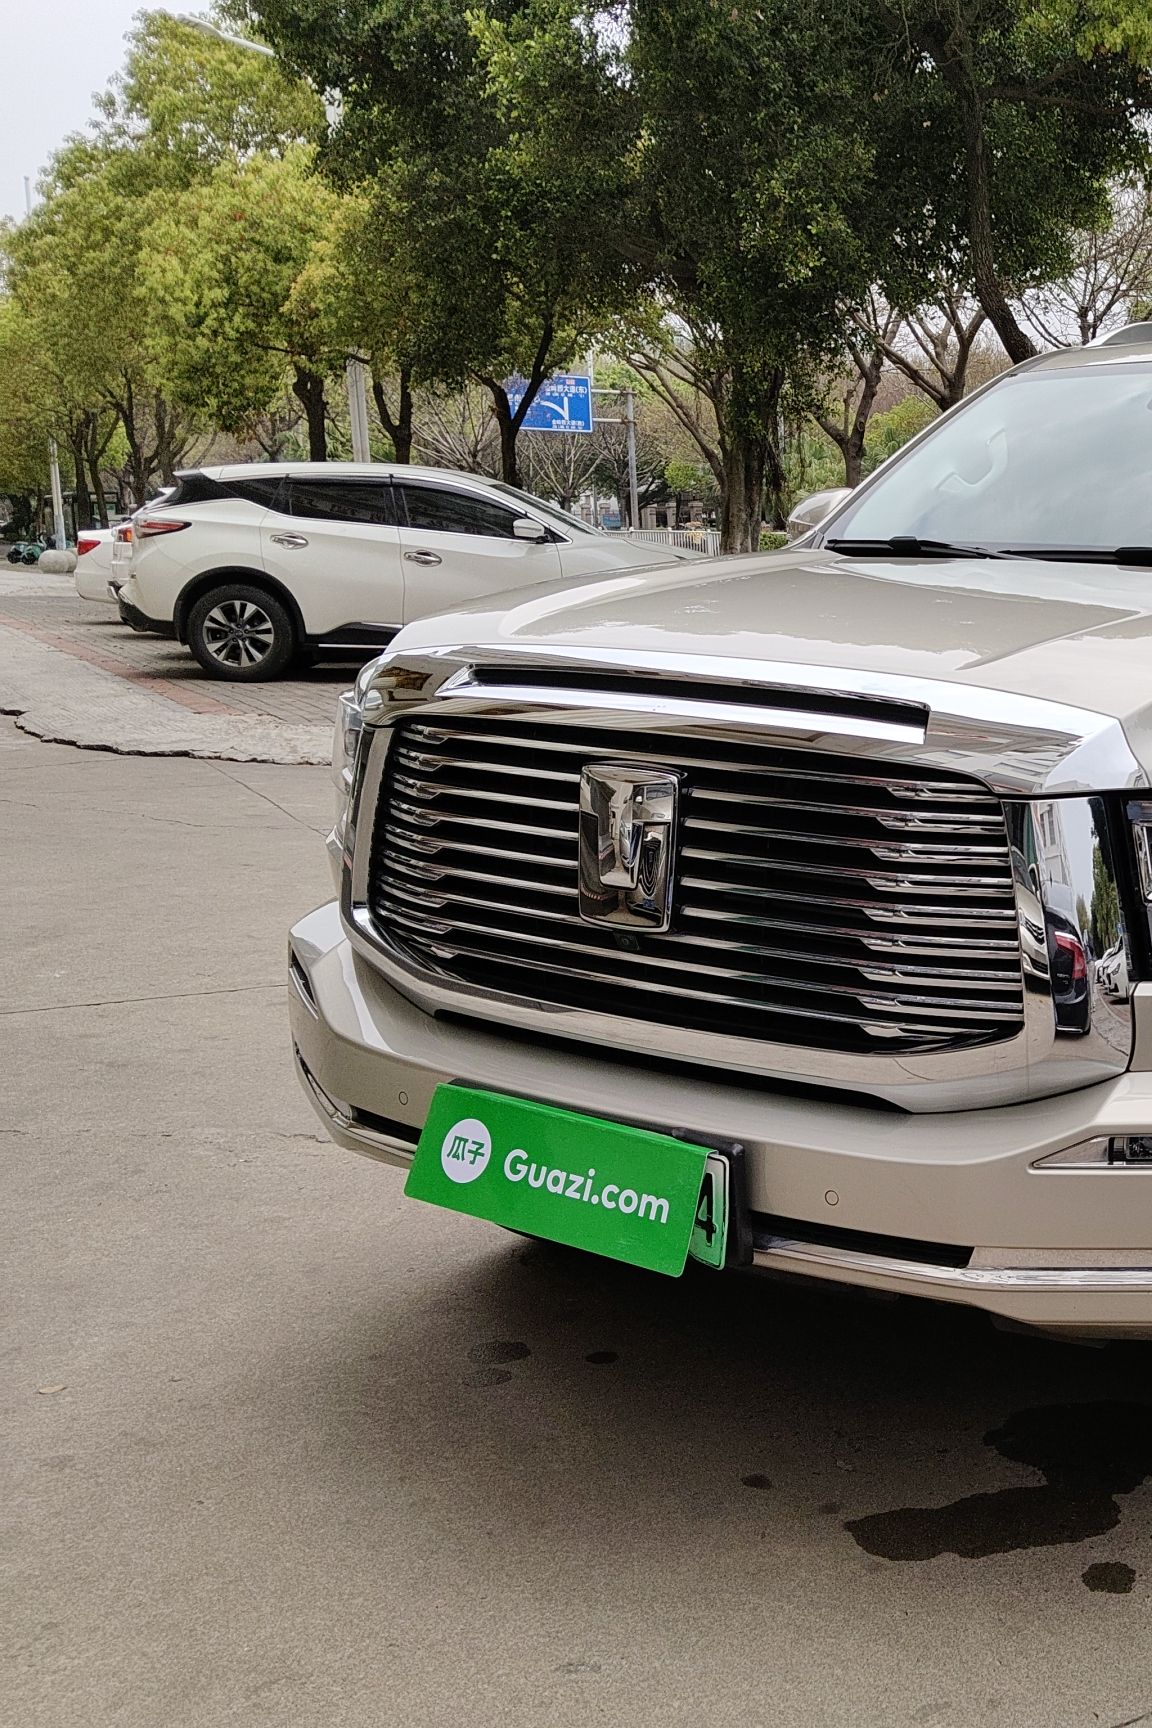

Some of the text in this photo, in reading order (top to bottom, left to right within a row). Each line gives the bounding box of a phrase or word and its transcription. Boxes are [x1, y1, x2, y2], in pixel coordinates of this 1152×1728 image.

[446, 1135, 486, 1165] 瓜子
[503, 1148, 670, 1224] Guazi.com
[695, 1172, 717, 1247] 4
